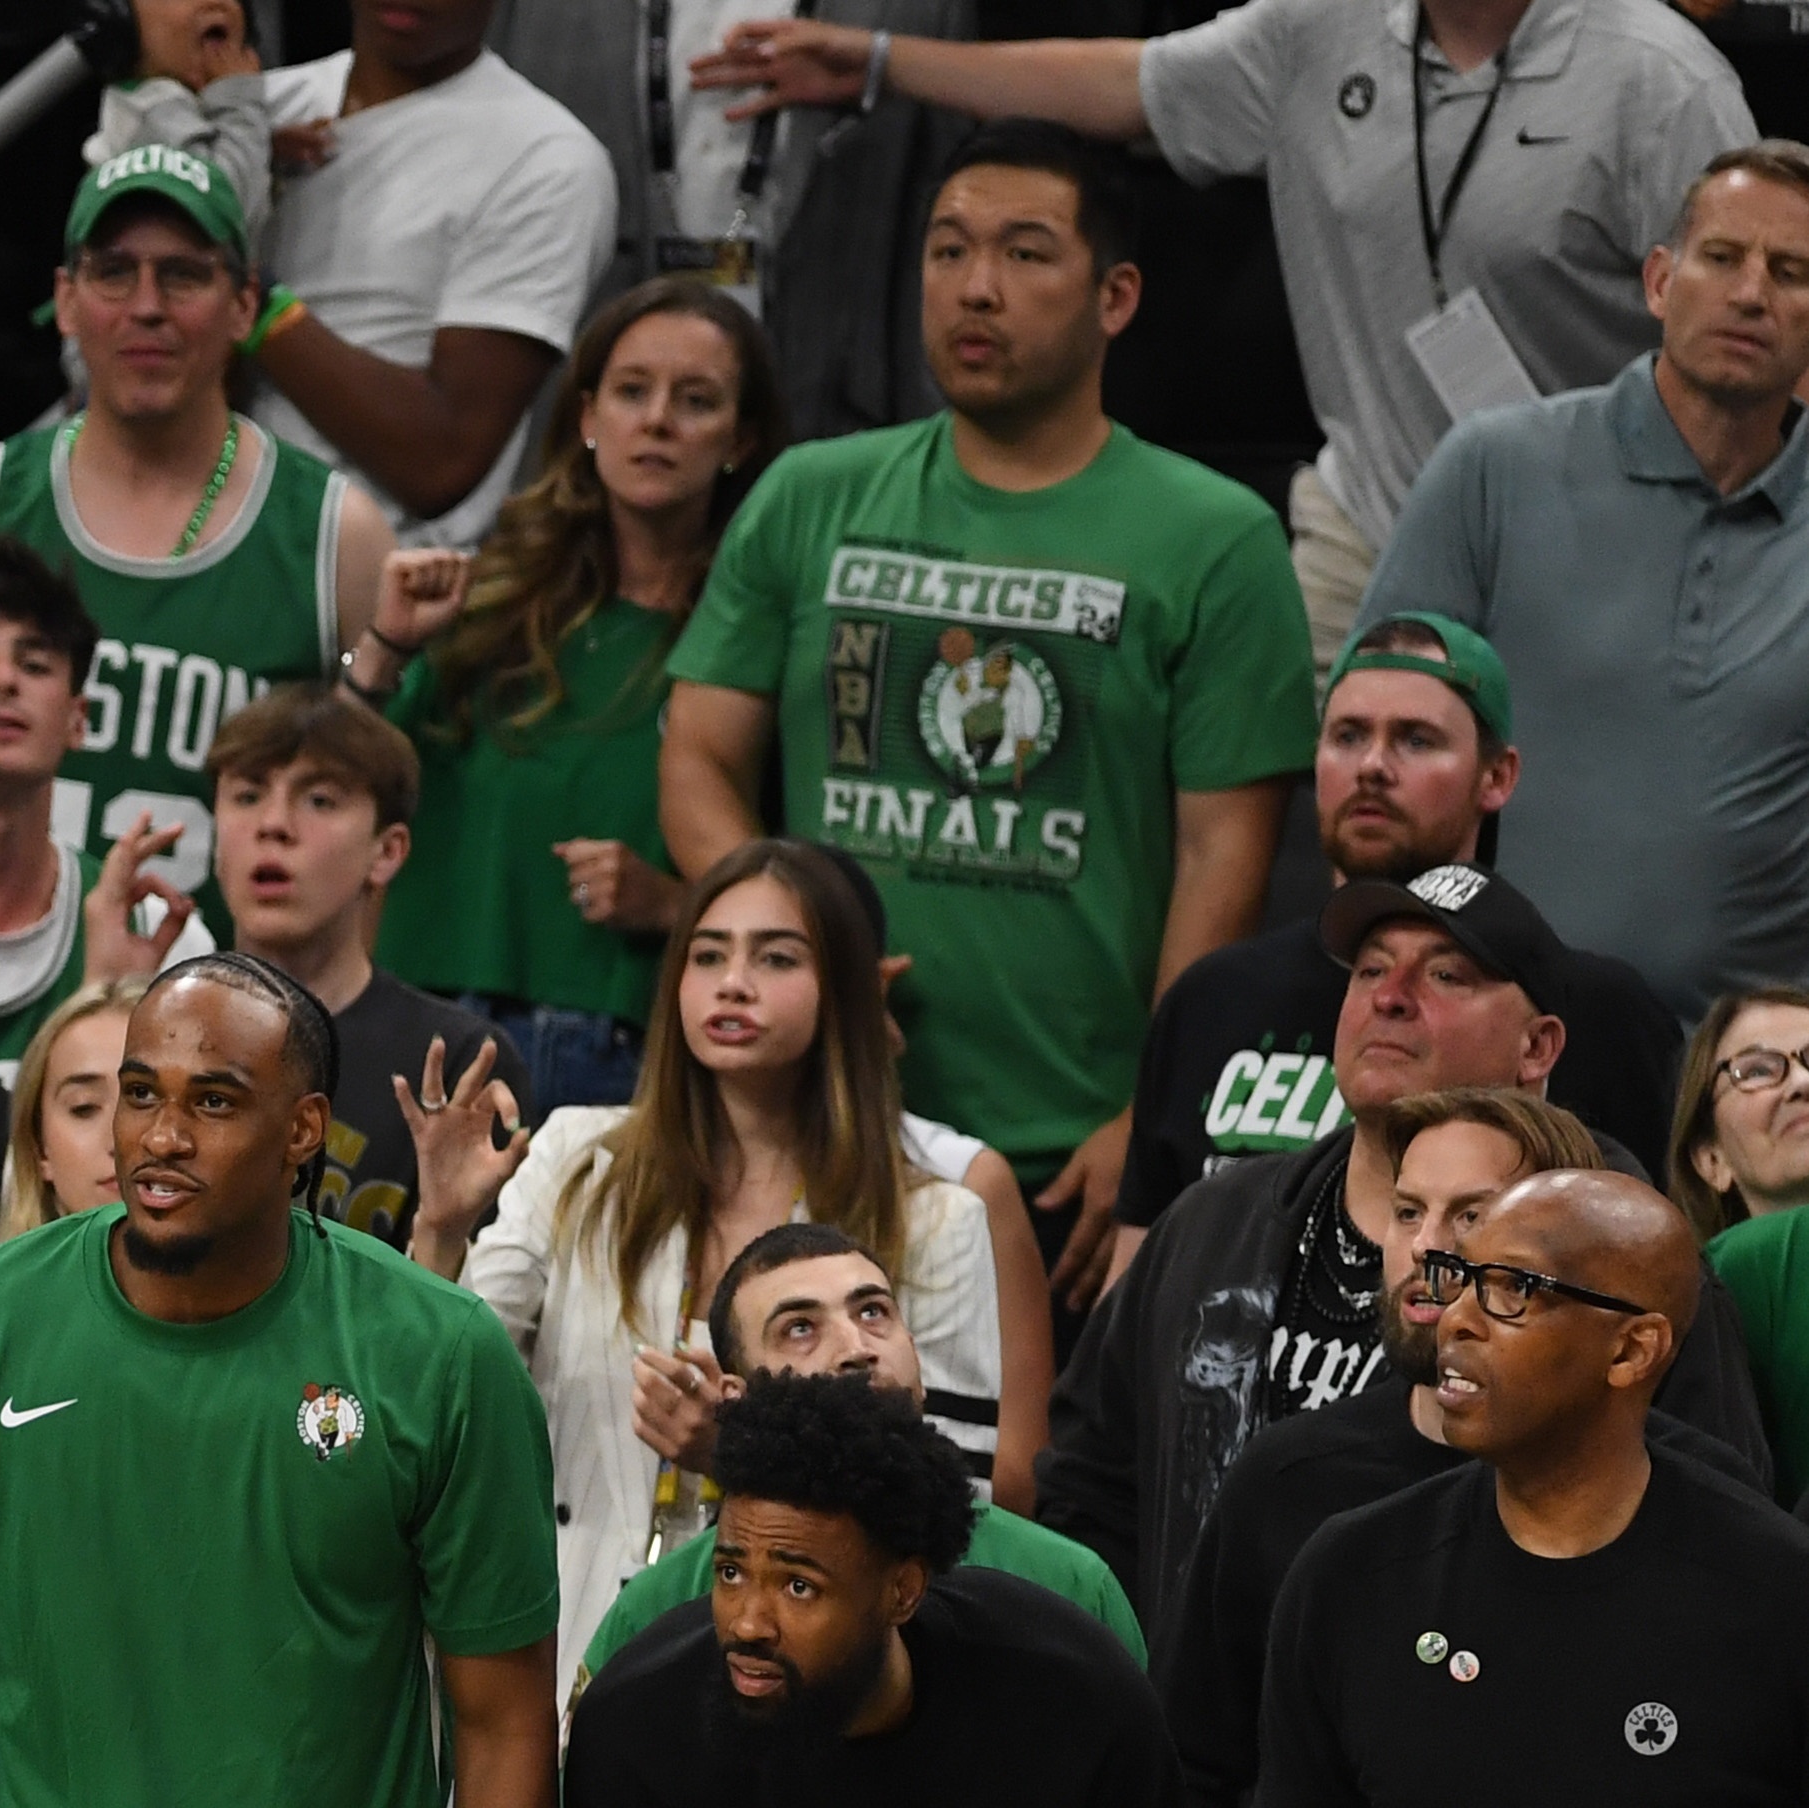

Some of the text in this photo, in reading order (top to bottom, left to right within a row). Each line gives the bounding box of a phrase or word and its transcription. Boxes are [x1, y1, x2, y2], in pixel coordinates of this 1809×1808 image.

[97, 145, 210, 193] CELTICS
[837, 556, 1066, 622] CELTICS
[823, 778, 1085, 876] FINALS
[1628, 1704, 1674, 1728] CELTICS
